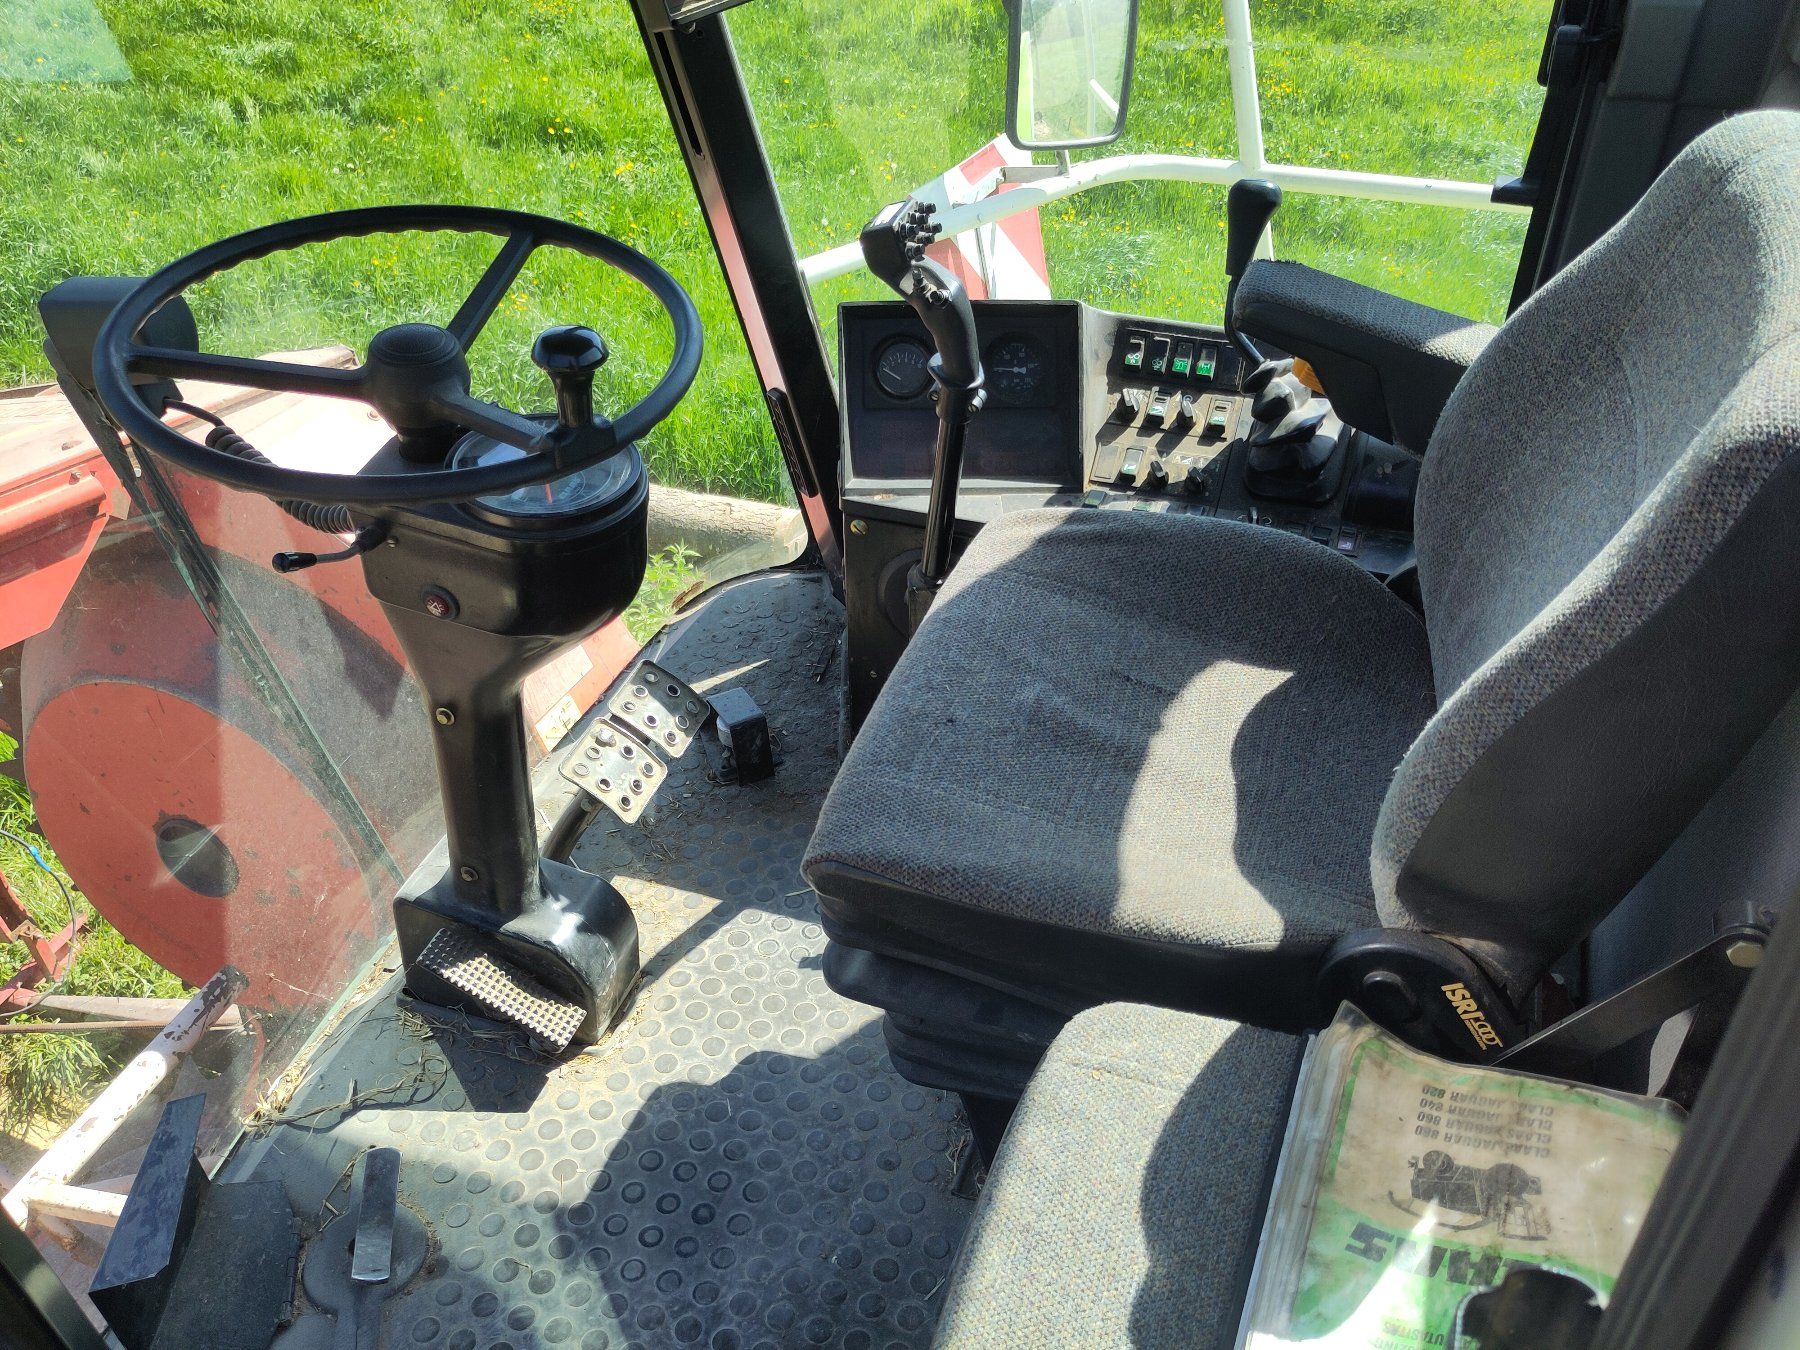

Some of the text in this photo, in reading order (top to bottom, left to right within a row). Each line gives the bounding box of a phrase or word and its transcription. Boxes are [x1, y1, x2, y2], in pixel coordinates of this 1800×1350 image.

[1441, 983, 1485, 1020] ISRI
[1422, 1084, 1446, 1099] 820
[1416, 1110, 1442, 1126] 860
[1508, 1113, 1553, 1130] CLAA
